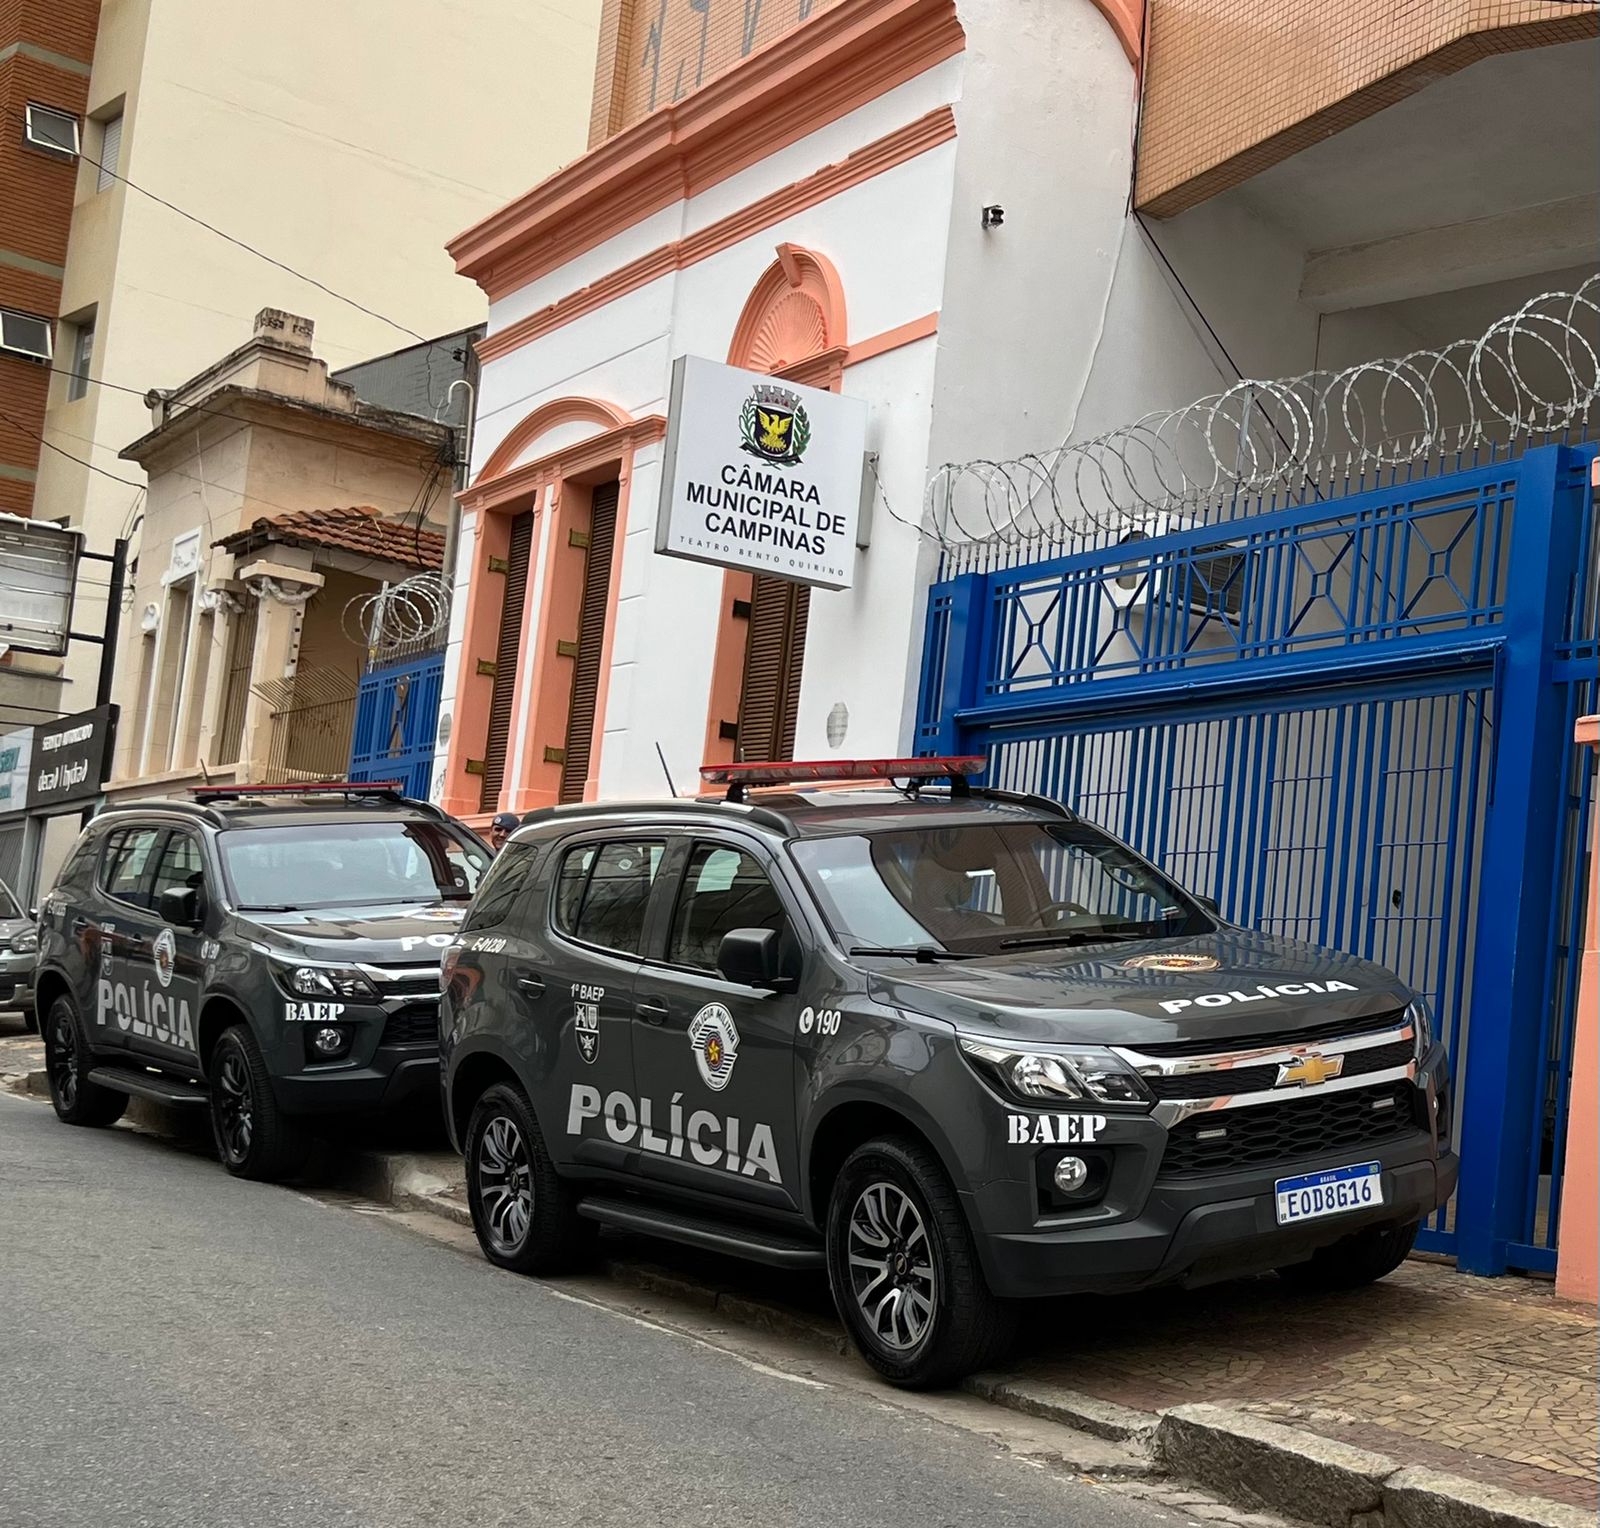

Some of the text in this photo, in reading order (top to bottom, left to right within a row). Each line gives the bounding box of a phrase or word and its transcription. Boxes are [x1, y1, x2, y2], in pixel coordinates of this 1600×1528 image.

[721, 464, 821, 505] CÂMARA
[686, 482, 847, 535] MUNICIPAL DE
[705, 512, 826, 555] CAMPINAS
[680, 535, 844, 576] TEATRO BENTO QUIRINO
[285, 1002, 345, 1021] BAEP
[580, 984, 605, 1002] BAEP
[1158, 979, 1359, 1015] POLÍCIA
[96, 978, 196, 1051] POLÍCIA
[816, 1008, 841, 1036] 190
[566, 1083, 783, 1184] POLÍCIA
[1007, 1114, 1107, 1144] BAEP
[1287, 1178, 1372, 1218] EOD8G16
